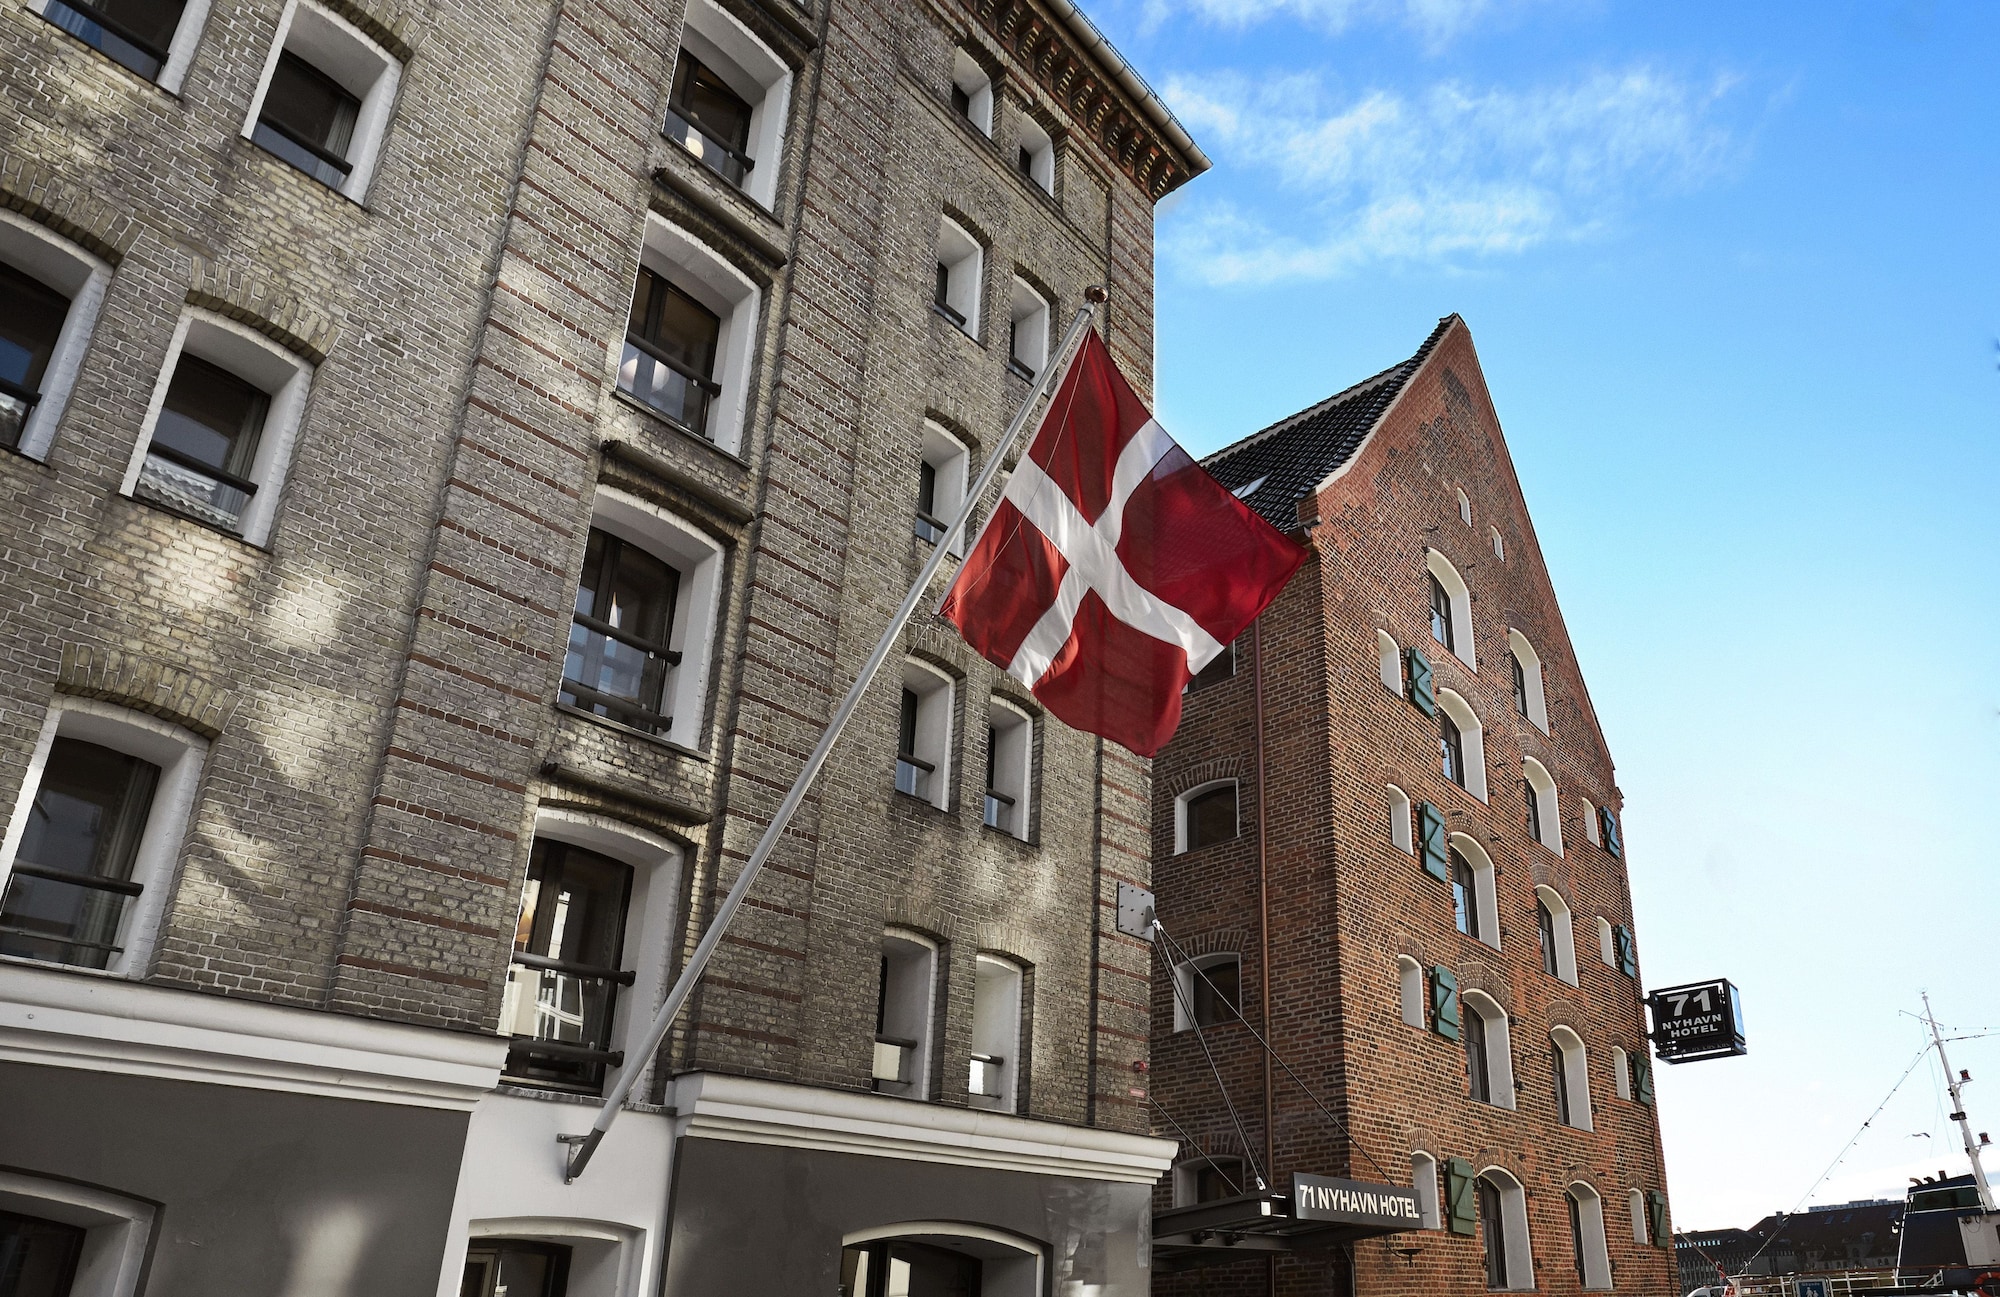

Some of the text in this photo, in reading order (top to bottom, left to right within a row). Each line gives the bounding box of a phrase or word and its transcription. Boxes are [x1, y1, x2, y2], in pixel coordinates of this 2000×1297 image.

[1667, 990, 1711, 1016] 71
[1662, 1014, 1721, 1030] NYHAVN
[1670, 1024, 1718, 1037] HOTEL
[1299, 1185, 1420, 1219] 71 NYHAVN HOTEL
